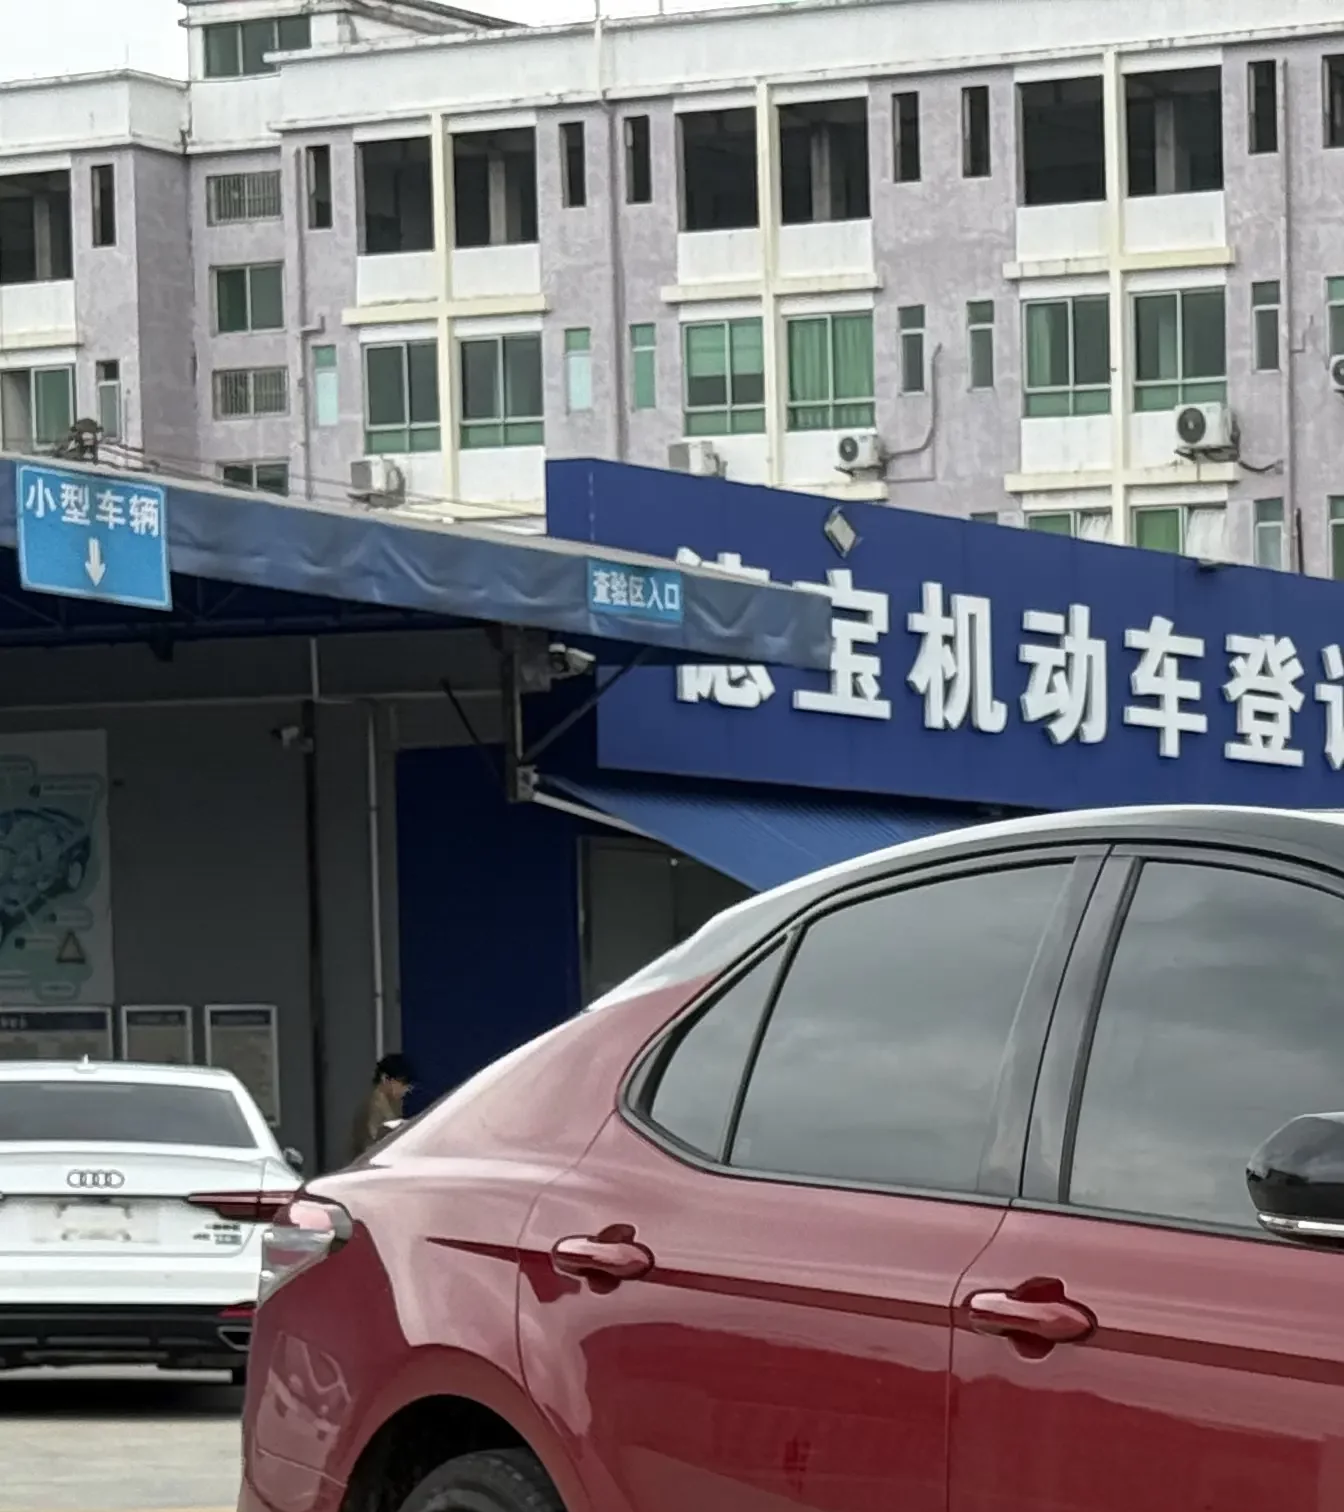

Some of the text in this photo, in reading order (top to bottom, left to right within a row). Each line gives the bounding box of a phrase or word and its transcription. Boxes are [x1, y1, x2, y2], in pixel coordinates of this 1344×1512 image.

[25, 477, 160, 538] 小型车辆
[592, 569, 680, 611] 查验区入口
